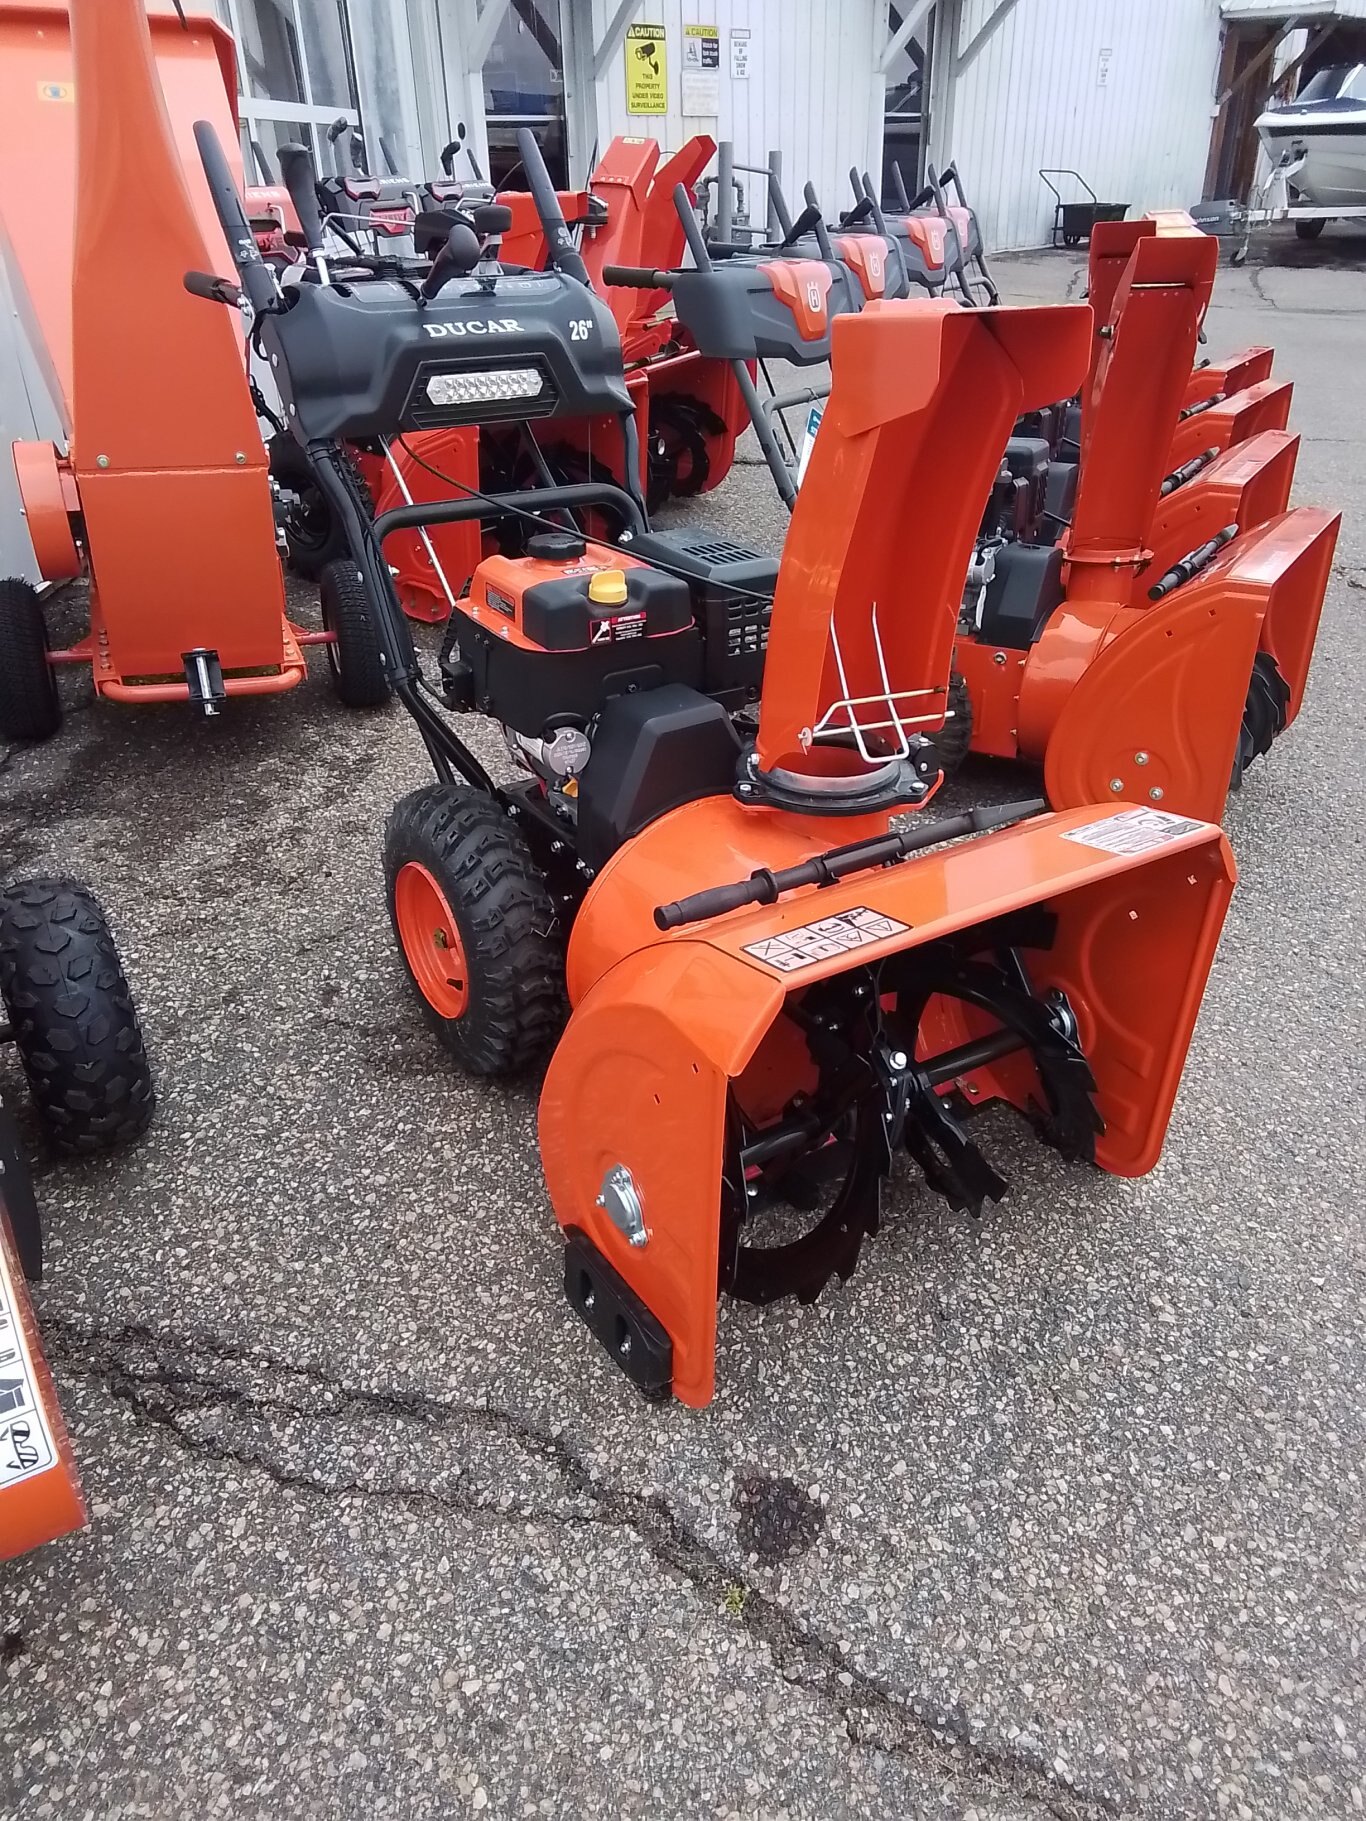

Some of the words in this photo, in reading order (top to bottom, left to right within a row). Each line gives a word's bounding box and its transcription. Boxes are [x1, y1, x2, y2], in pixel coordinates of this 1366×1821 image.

[635, 26, 665, 38] CAUTION
[691, 28, 718, 37] CAUTION
[423, 319, 525, 338] DUCAR
[569, 319, 593, 341] 26"
